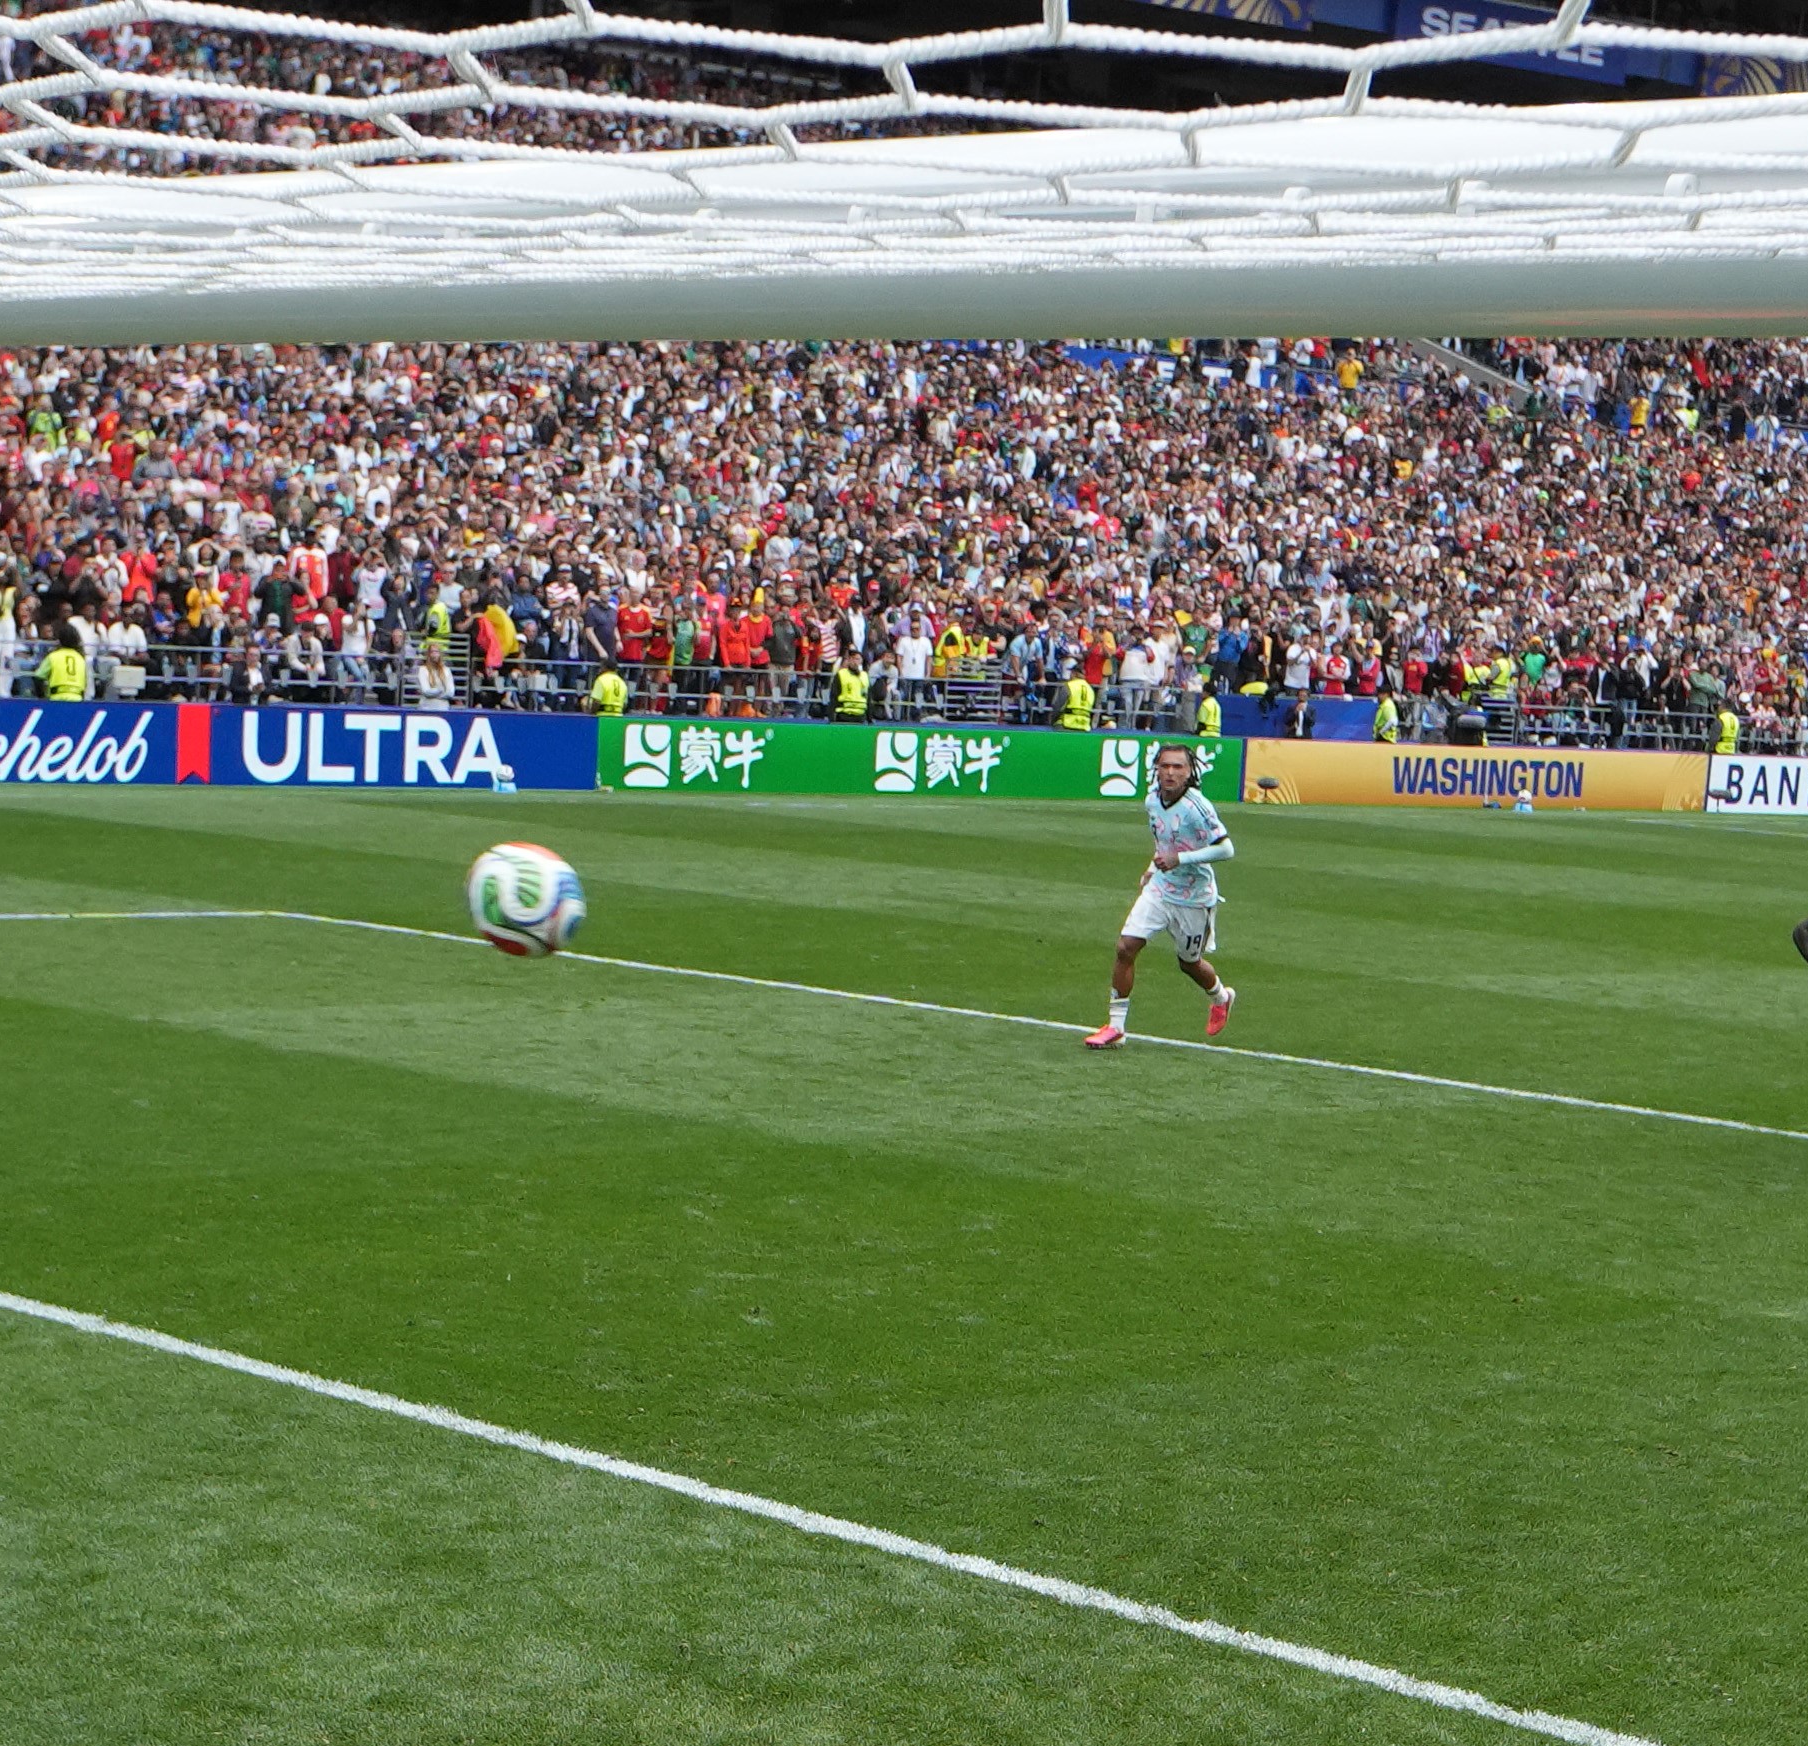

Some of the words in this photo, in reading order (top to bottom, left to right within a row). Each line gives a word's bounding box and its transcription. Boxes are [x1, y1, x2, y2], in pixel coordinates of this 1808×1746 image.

[242, 710, 507, 785] ULTRA
[679, 726, 765, 789] 蒙牛
[924, 733, 1002, 793] 蒙牛
[1392, 756, 1583, 798] WASHINGTON
[1186, 933, 1203, 951] 19
